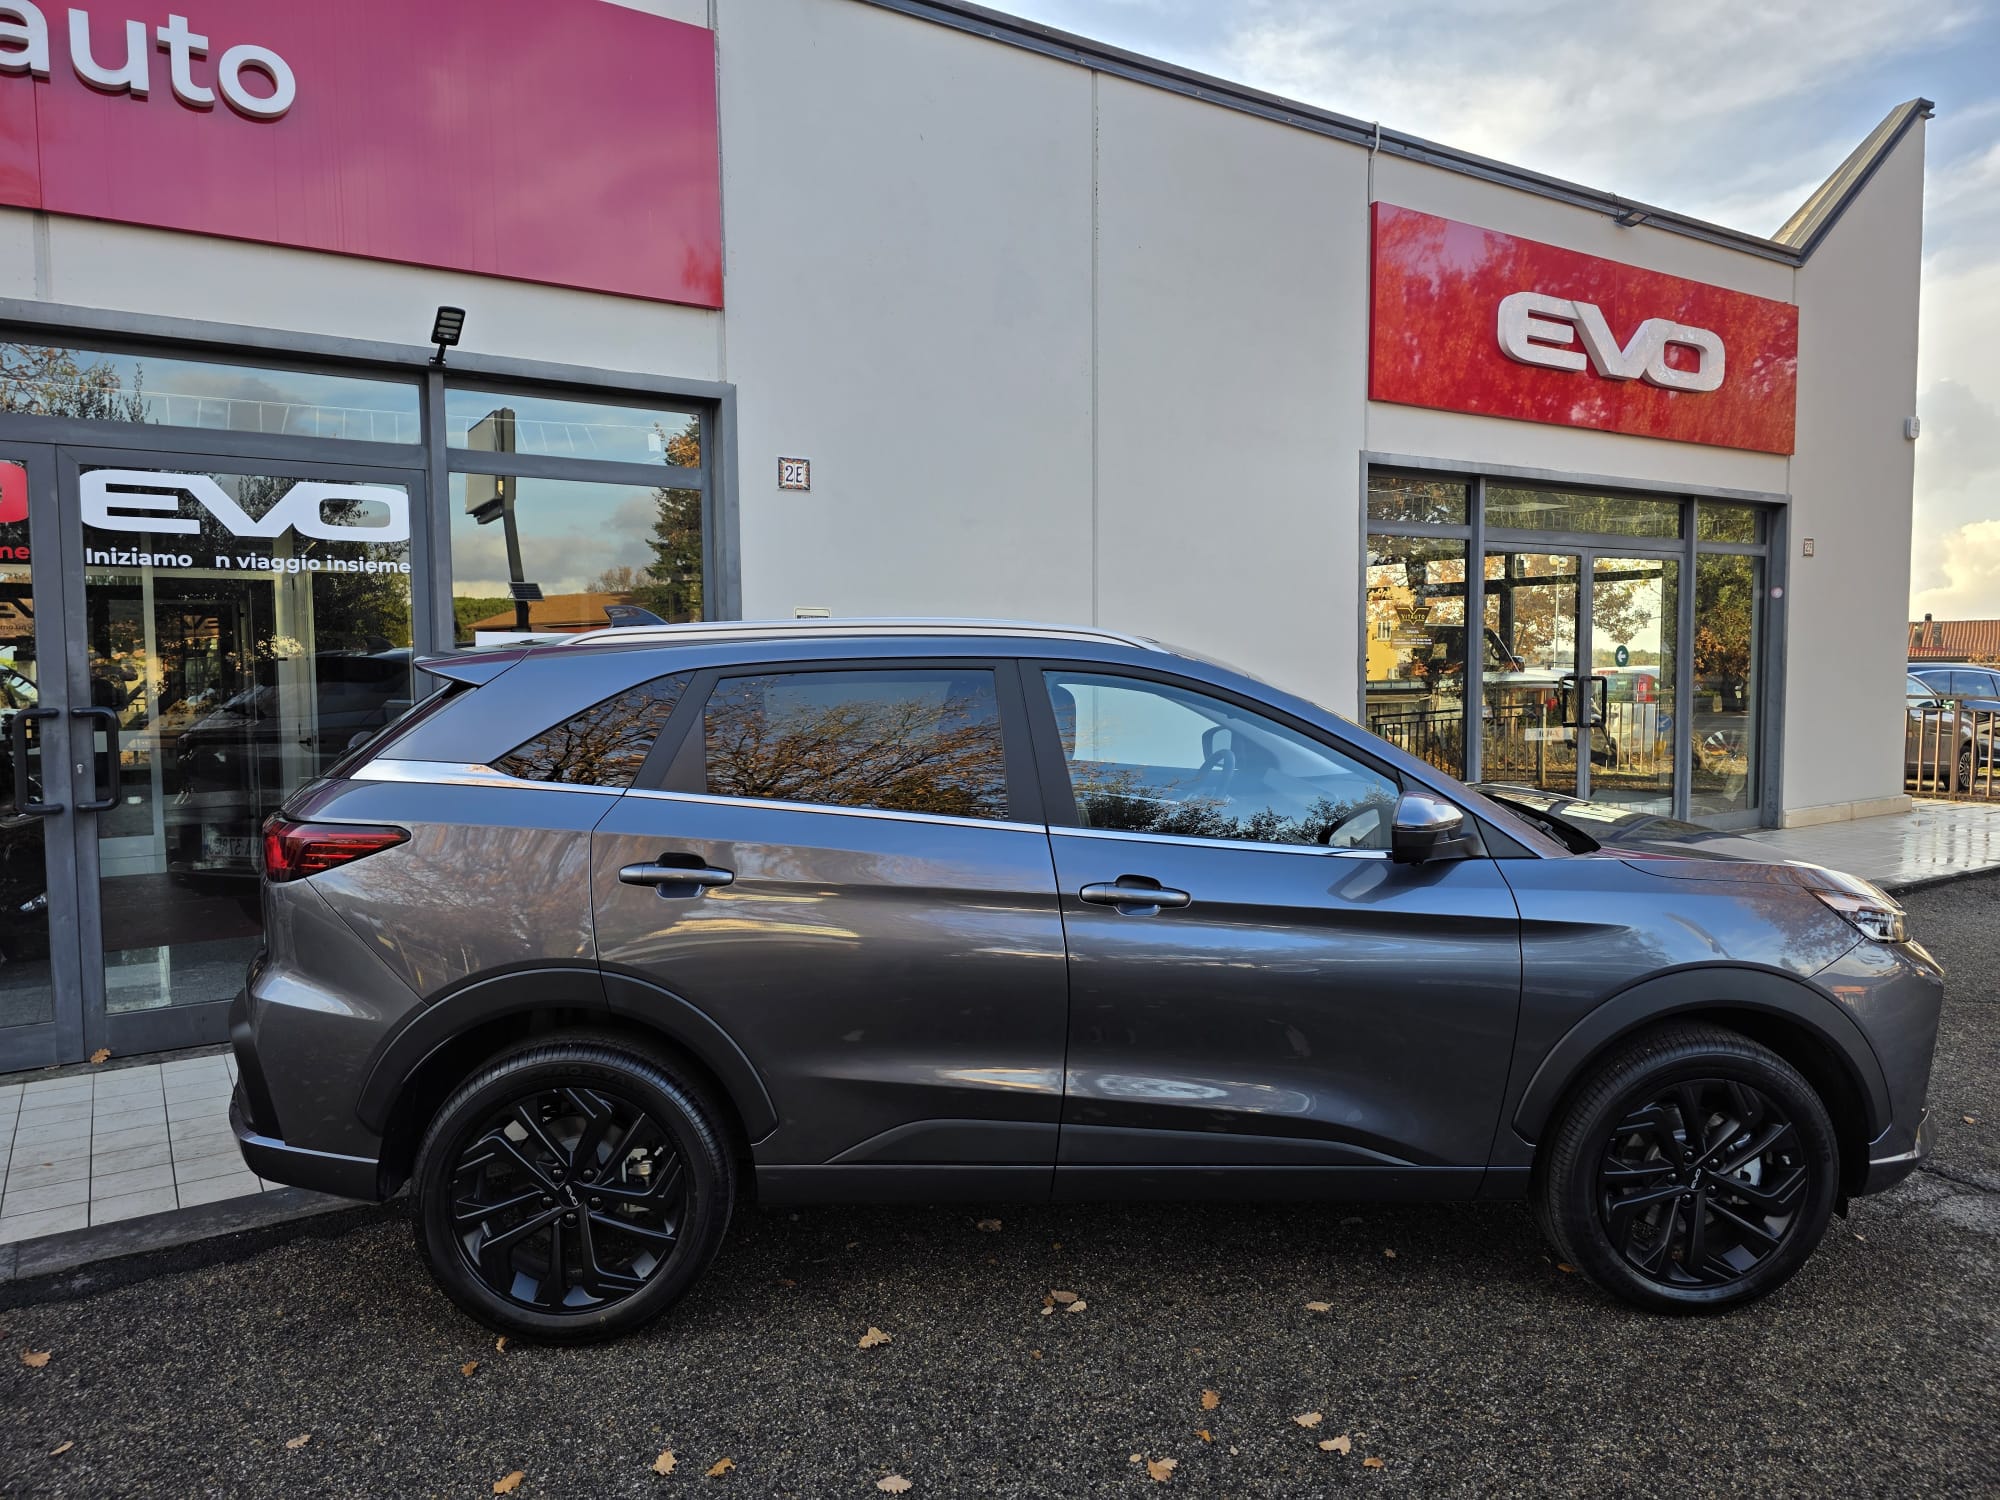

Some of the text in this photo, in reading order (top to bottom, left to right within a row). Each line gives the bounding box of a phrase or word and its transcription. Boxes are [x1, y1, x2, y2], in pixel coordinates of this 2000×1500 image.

[0, 0, 297, 118] auto
[1498, 291, 1725, 391] EVO
[79, 468, 411, 543] EVO
[785, 465, 803, 483] 2E
[86, 547, 193, 568] Iniziamo
[237, 552, 321, 575] viaggio
[327, 554, 411, 574] insieme
